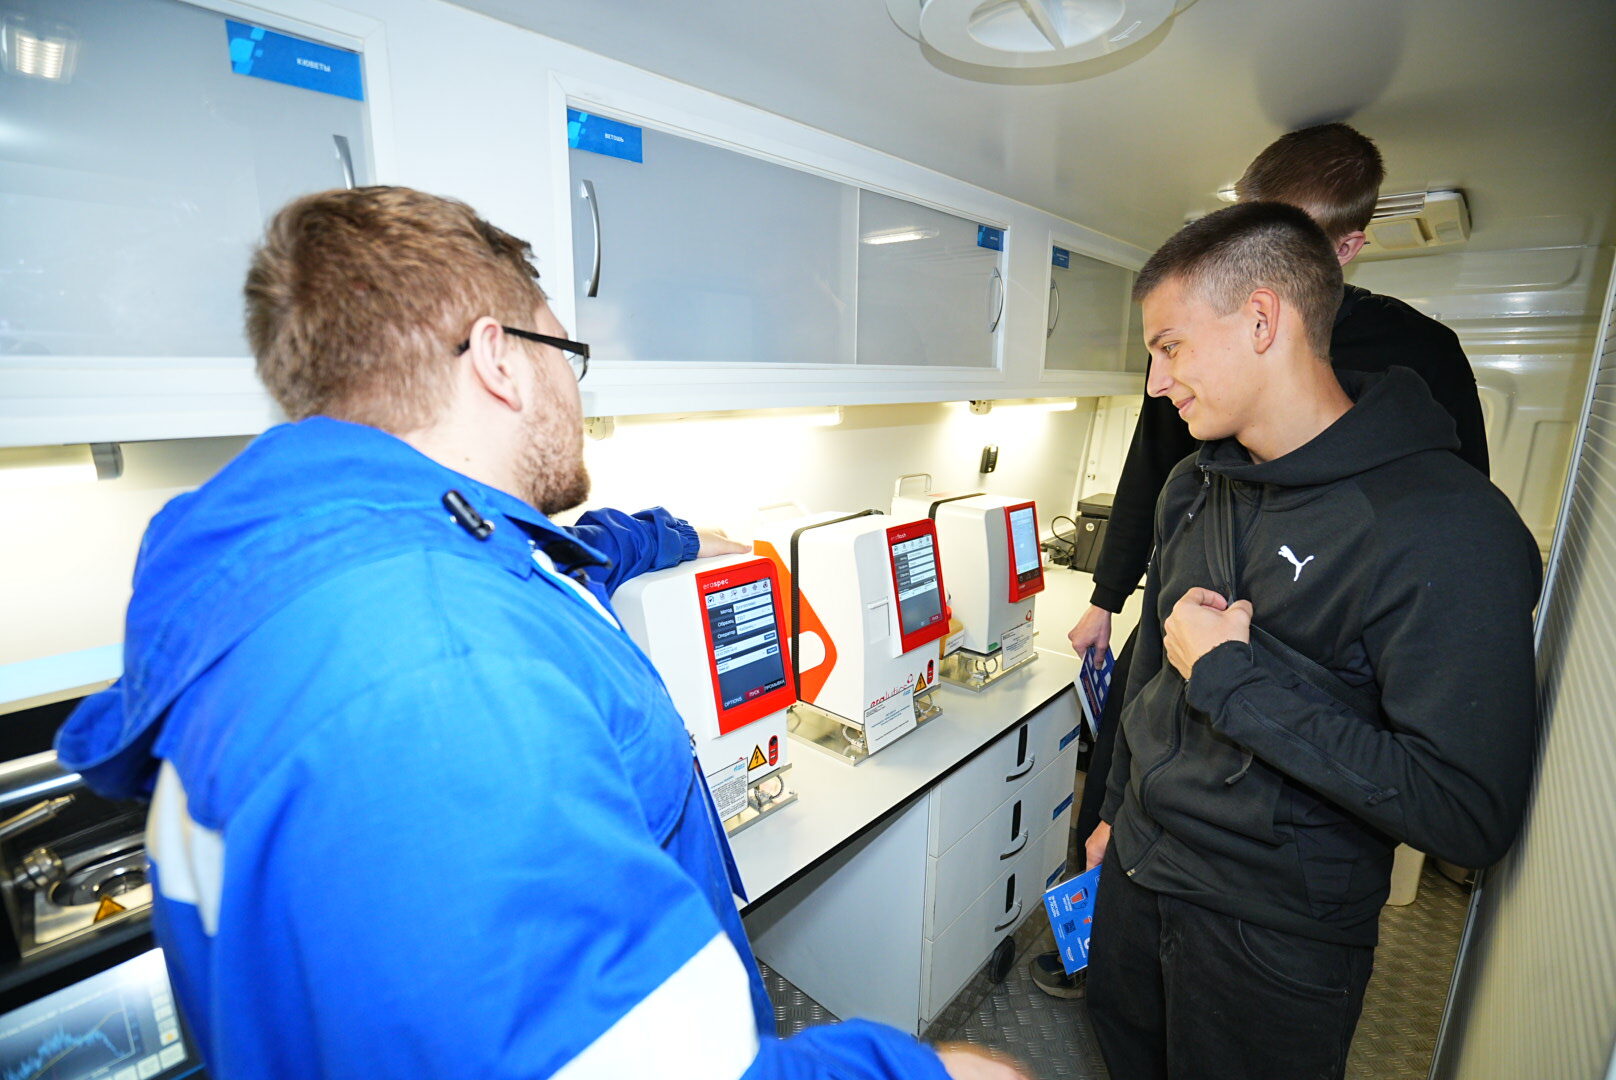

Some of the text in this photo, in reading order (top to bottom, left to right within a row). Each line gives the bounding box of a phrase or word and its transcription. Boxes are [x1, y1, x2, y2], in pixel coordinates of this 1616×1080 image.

[296, 57, 331, 73] КЮВЕТЫ
[604, 132, 625, 143] ВЕТОШЬ
[703, 578, 729, 590] eraspec
[724, 696, 743, 707] OPTIONS
